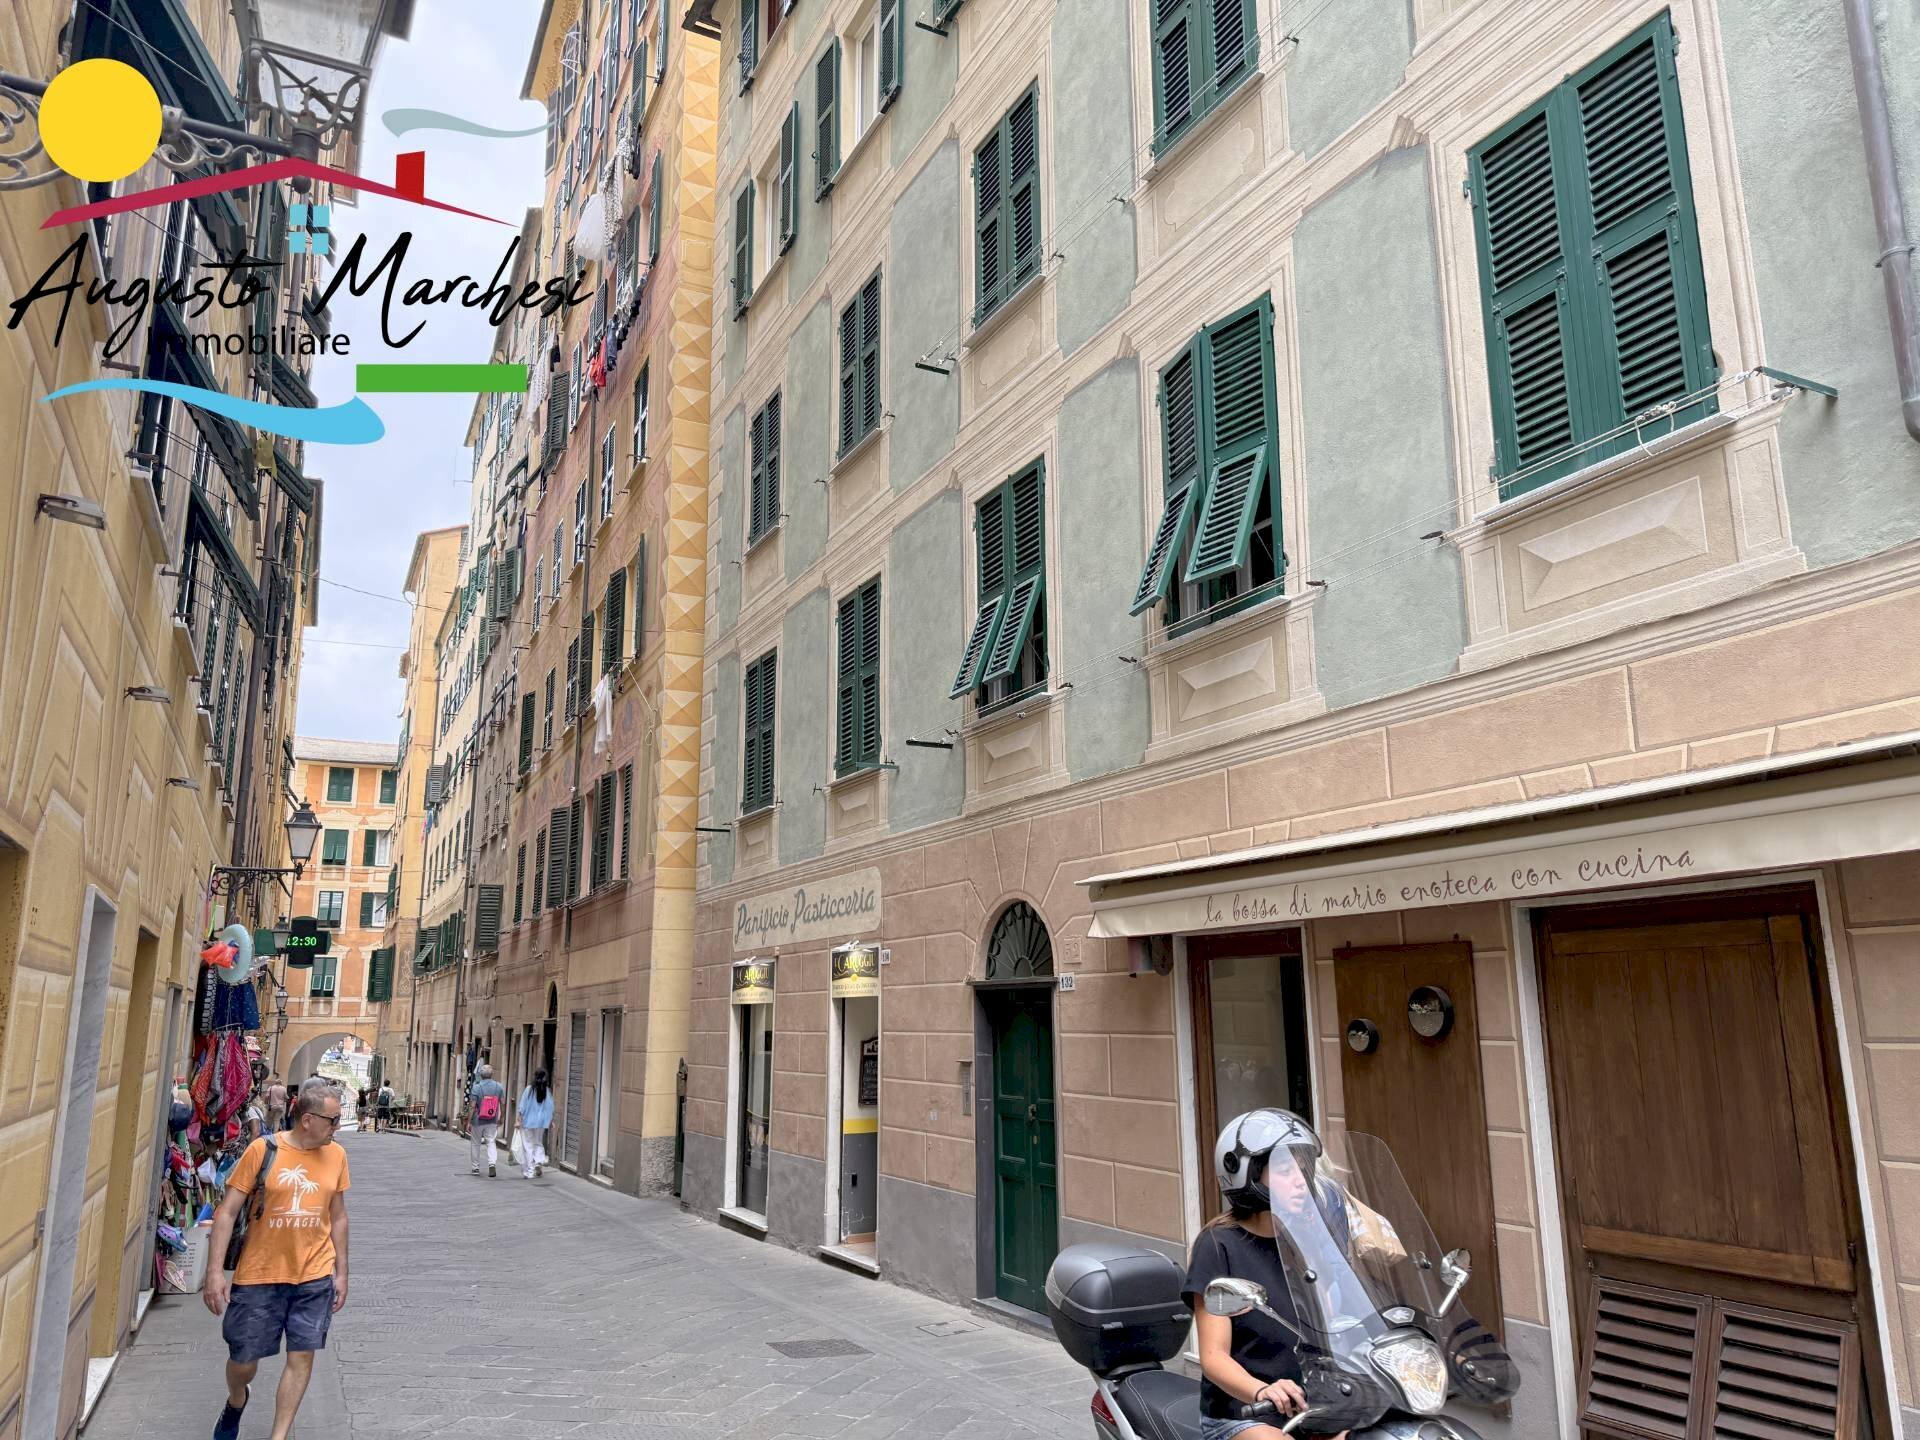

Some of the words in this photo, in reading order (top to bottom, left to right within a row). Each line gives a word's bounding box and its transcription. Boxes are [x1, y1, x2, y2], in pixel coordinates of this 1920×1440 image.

[1204, 895, 1224, 926] la
[1232, 893, 1279, 922] bossa
[1289, 884, 1313, 916] di
[1322, 884, 1387, 911] mario
[1400, 869, 1498, 901] enoteca
[1511, 867, 1562, 890] con
[1577, 847, 1695, 882] cucina
[734, 903, 790, 946] Panificio
[790, 887, 876, 934] Pasticceria
[286, 936, 317, 946] 12:30
[1061, 976, 1073, 988] 132
[269, 1217, 321, 1228] VOYAGER
